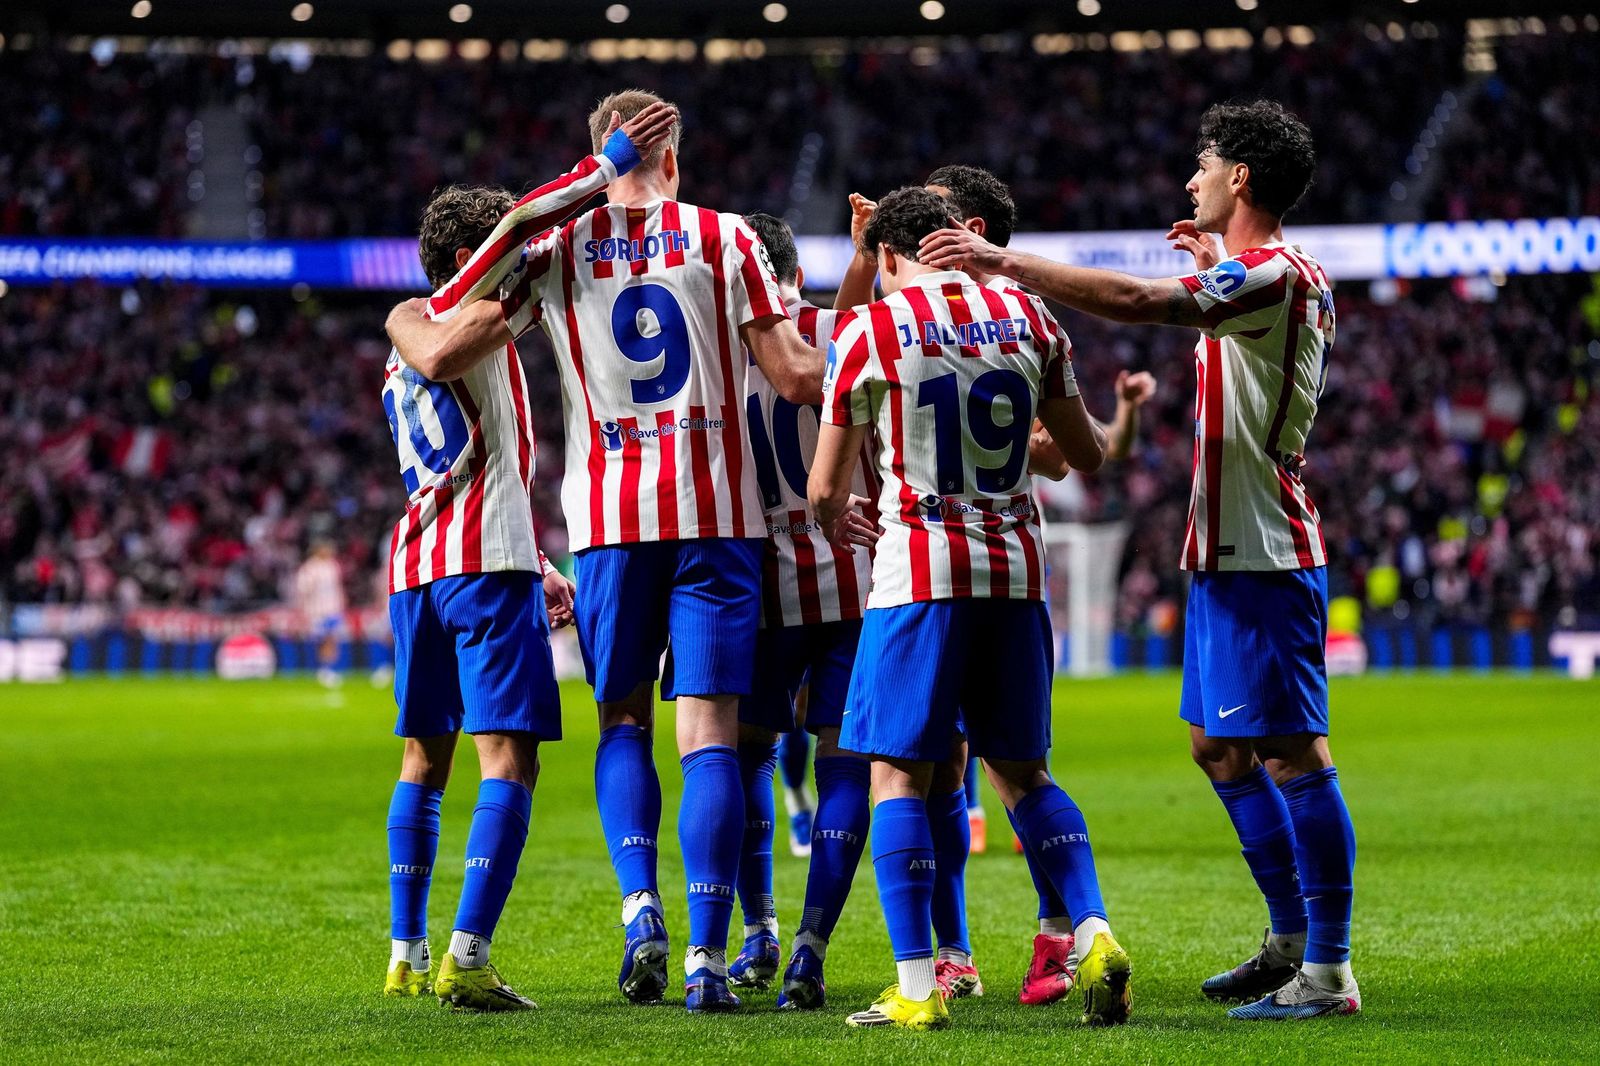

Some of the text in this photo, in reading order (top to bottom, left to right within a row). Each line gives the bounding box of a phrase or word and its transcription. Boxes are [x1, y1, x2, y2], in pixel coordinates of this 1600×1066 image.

[585, 230, 690, 262] SØRLOTH
[611, 283, 691, 404] 9
[629, 417, 727, 441] Save the Children
[917, 368, 1032, 495] 19
[767, 523, 791, 534] Save
[793, 521, 811, 533] the
[815, 829, 857, 845] ATLETI
[1042, 833, 1088, 851] ATLETI
[391, 863, 429, 875] ATLETI
[689, 882, 730, 897] ATLETI
